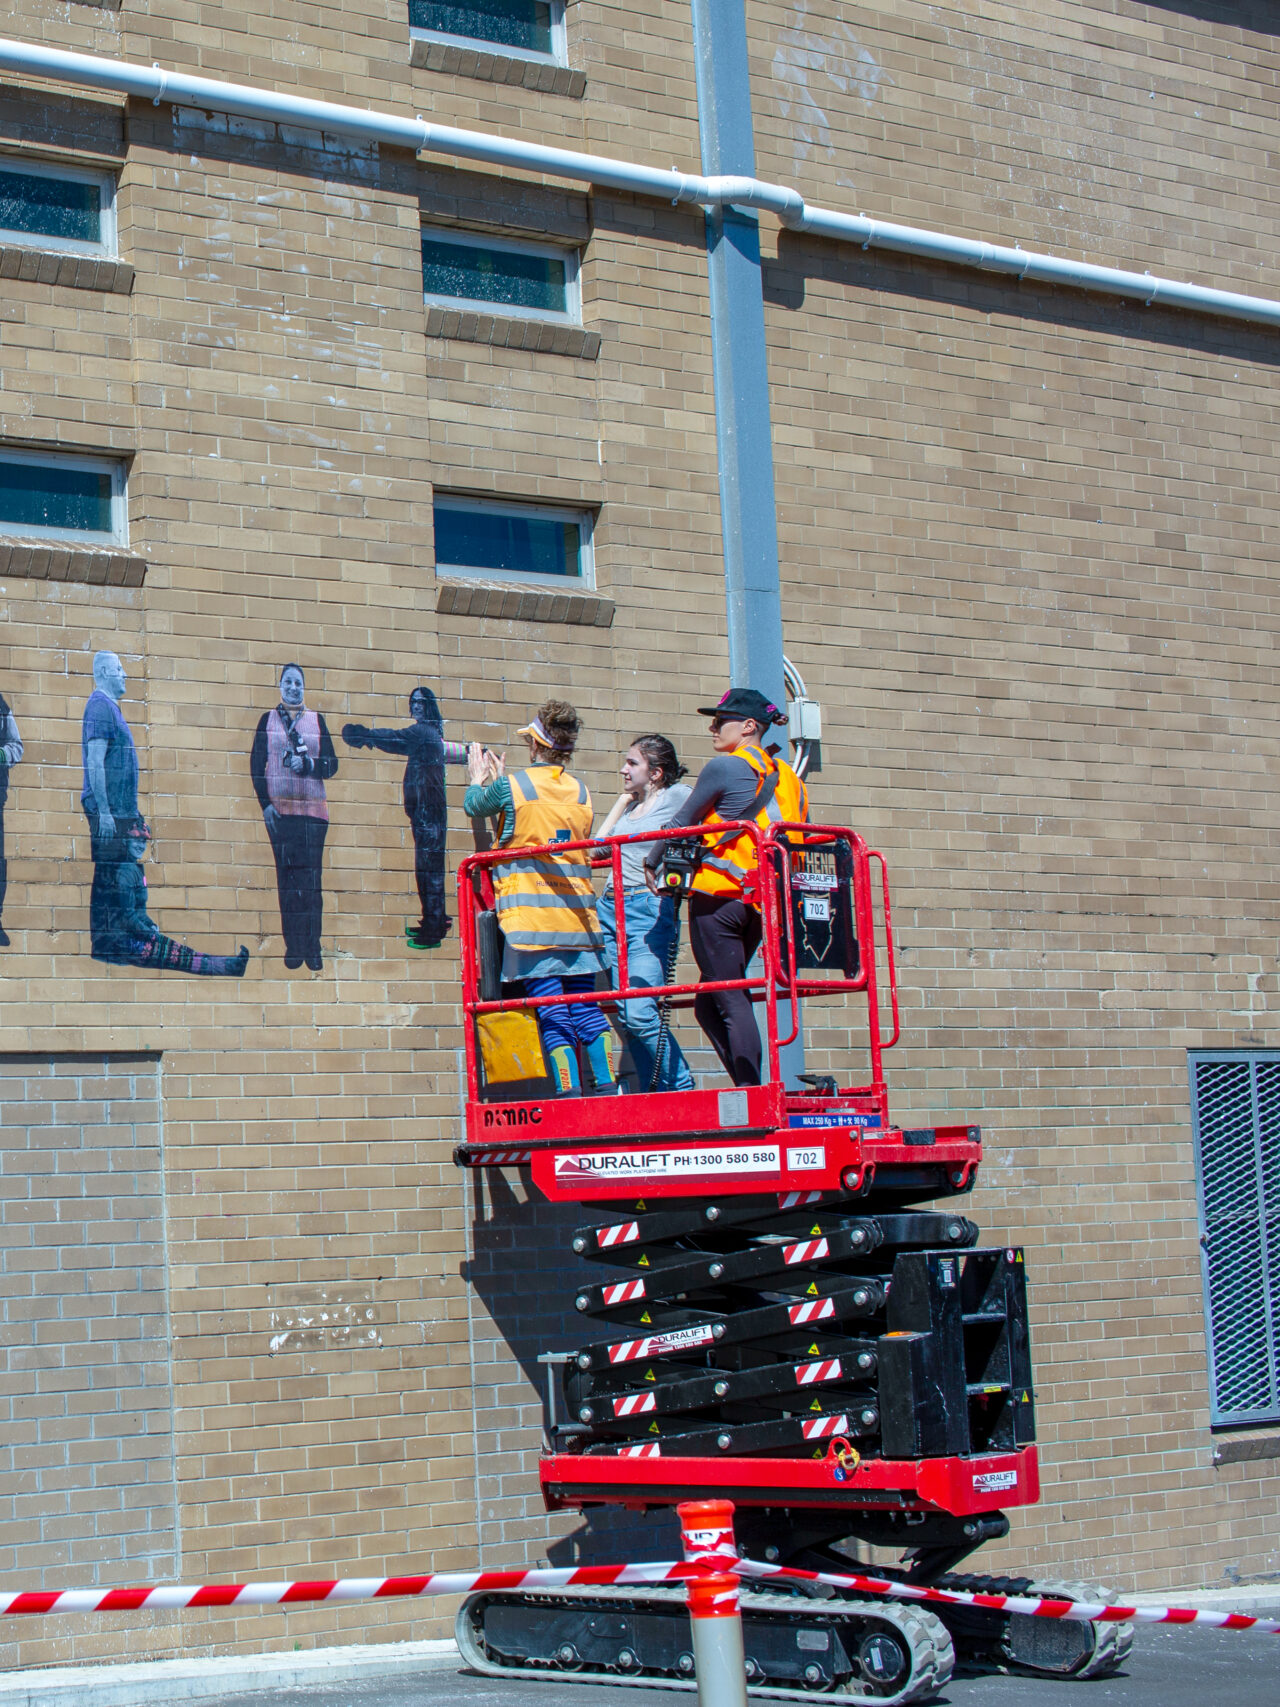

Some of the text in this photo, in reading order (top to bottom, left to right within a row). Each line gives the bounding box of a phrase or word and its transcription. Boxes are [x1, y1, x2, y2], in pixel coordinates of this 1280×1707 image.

[791, 851, 836, 874] ATHENA
[809, 903, 824, 915] 702
[802, 1117, 814, 1125] MAX
[824, 1117, 832, 1126] Kg
[860, 1117, 868, 1126] Kg
[579, 1154, 670, 1170] DURALIFT
[726, 1153, 748, 1164] 580
[753, 1152, 775, 1163] 580
[795, 1152, 817, 1165] 702
[658, 1327, 707, 1342] DURALIFT
[981, 1472, 1014, 1483] DURALIFT
